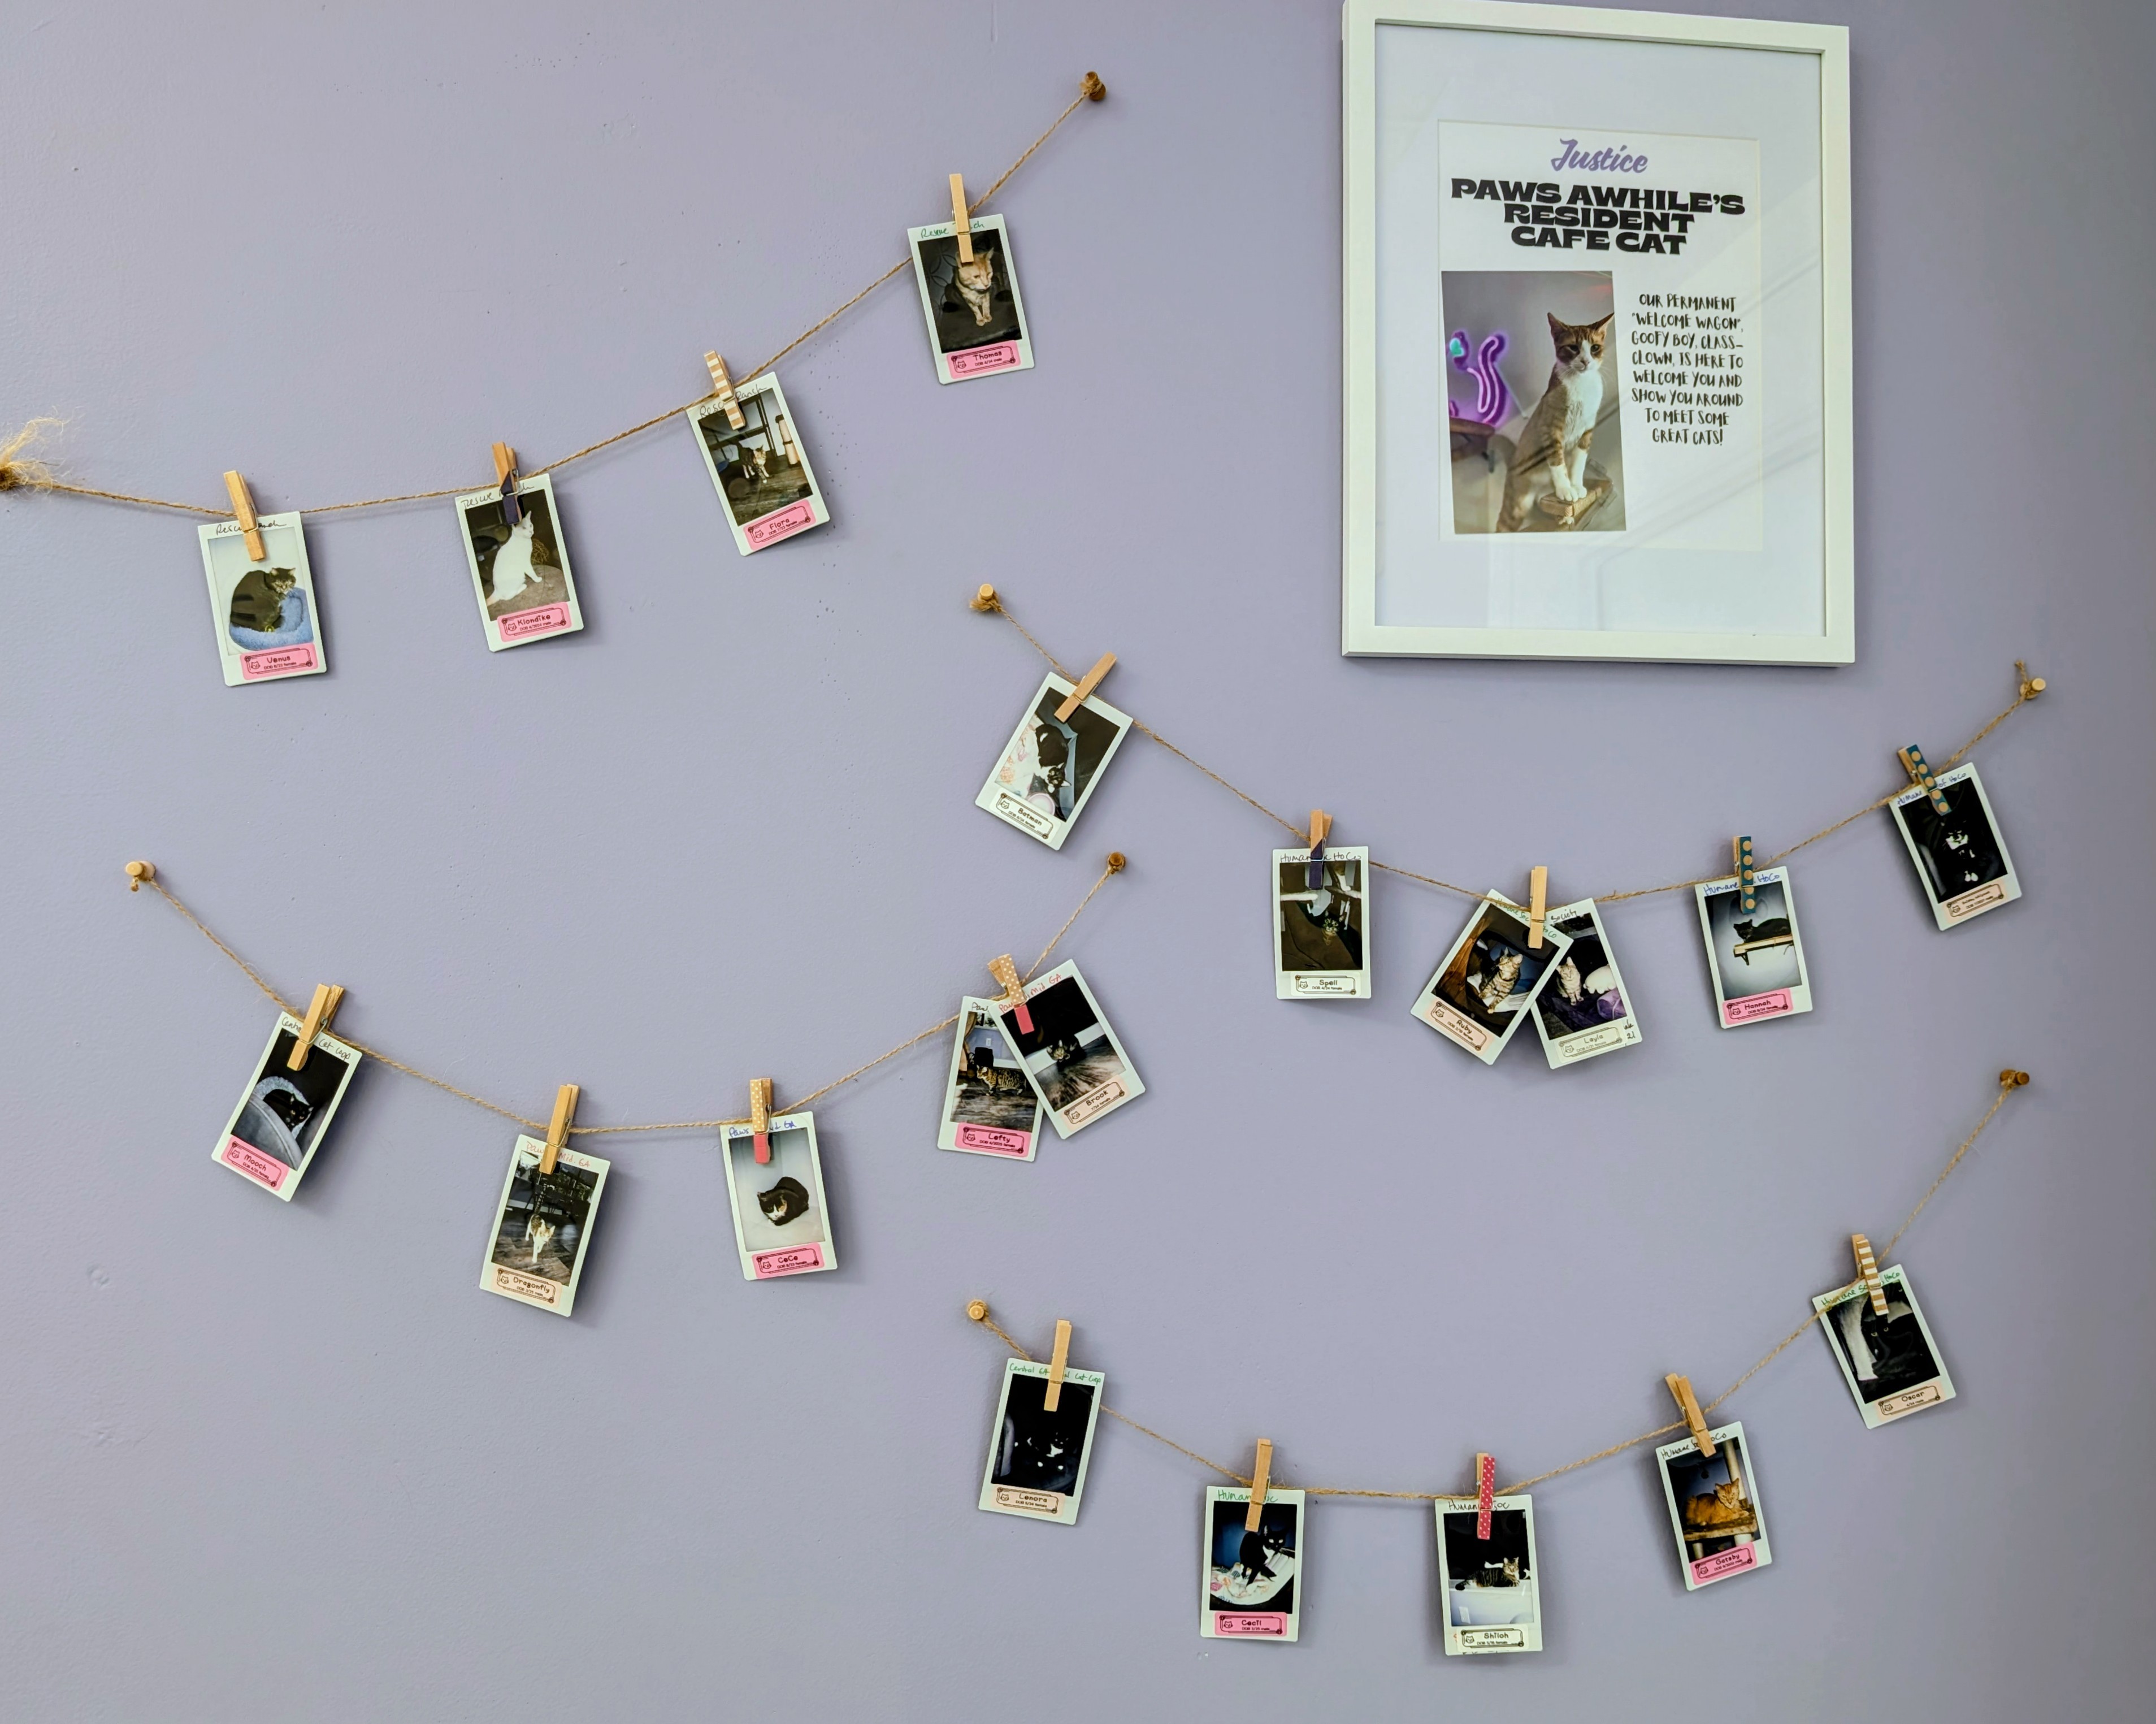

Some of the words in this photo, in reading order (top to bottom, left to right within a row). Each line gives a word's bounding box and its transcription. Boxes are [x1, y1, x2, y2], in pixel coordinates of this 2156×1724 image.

[1551, 138, 1647, 174] Justice
[1451, 178, 1561, 203] PAWS
[1567, 185, 1745, 215] AWHILE'S
[1504, 203, 1694, 233] RESIDENT
[921, 228, 949, 238] Rescue
[1511, 226, 1610, 251] CAFE
[1616, 231, 1686, 255] CAT
[1639, 294, 1663, 307] OUR
[1667, 294, 1737, 311] PERMANENT
[1632, 332, 1669, 348] GOOFY
[973, 351, 1002, 361] Thomas
[1680, 354, 1691, 367] IS
[1695, 354, 1724, 369] HERE
[1729, 357, 1743, 369] TO
[1633, 371, 1688, 385] WELCOME
[1692, 373, 1716, 389] YOU
[1719, 375, 1742, 388] AND
[1632, 389, 1666, 404] SHOW
[1669, 390, 1692, 405] YOU
[1696, 394, 1743, 407] AROUND
[700, 404, 724, 417] Resc
[1645, 409, 1660, 423] TO
[1663, 410, 1693, 426] MEET
[1698, 411, 1729, 426] SOME
[1652, 428, 1689, 444] GREAT
[1693, 429, 1723, 445] CATS!
[216, 523, 242, 535] Rescu
[258, 520, 287, 530] anch
[769, 519, 789, 530] Flora
[518, 615, 550, 626] Klondike
[1018, 808, 1042, 825] Batman
[1281, 853, 1311, 863] Human
[1551, 908, 1578, 923] Society
[971, 1002, 990, 1011] Paw
[999, 1003, 1013, 1013] Paw
[1745, 1000, 1771, 1010] Hannah
[282, 1016, 302, 1033] Centra
[1456, 1020, 1472, 1034] Ruby
[1584, 1034, 1603, 1043] Layla
[1086, 1090, 1108, 1106] Brook
[729, 1127, 749, 1138] Paws
[988, 1133, 1010, 1143] Lefty
[527, 1141, 544, 1154] Paw
[244, 1154, 266, 1171] Mooch
[514, 1277, 549, 1293] Dragonfly
[1858, 1284, 1868, 1293] So
[1009, 1363, 1034, 1373] Central
[1902, 1392, 1924, 1402] Oscar
[1711, 1433, 1728, 1443] oCo
[1020, 1493, 1047, 1502] Lenora
[1218, 1489, 1252, 1501] Human
[1448, 1499, 1480, 1511] Human
[1715, 1554, 1739, 1565] Gatsby
